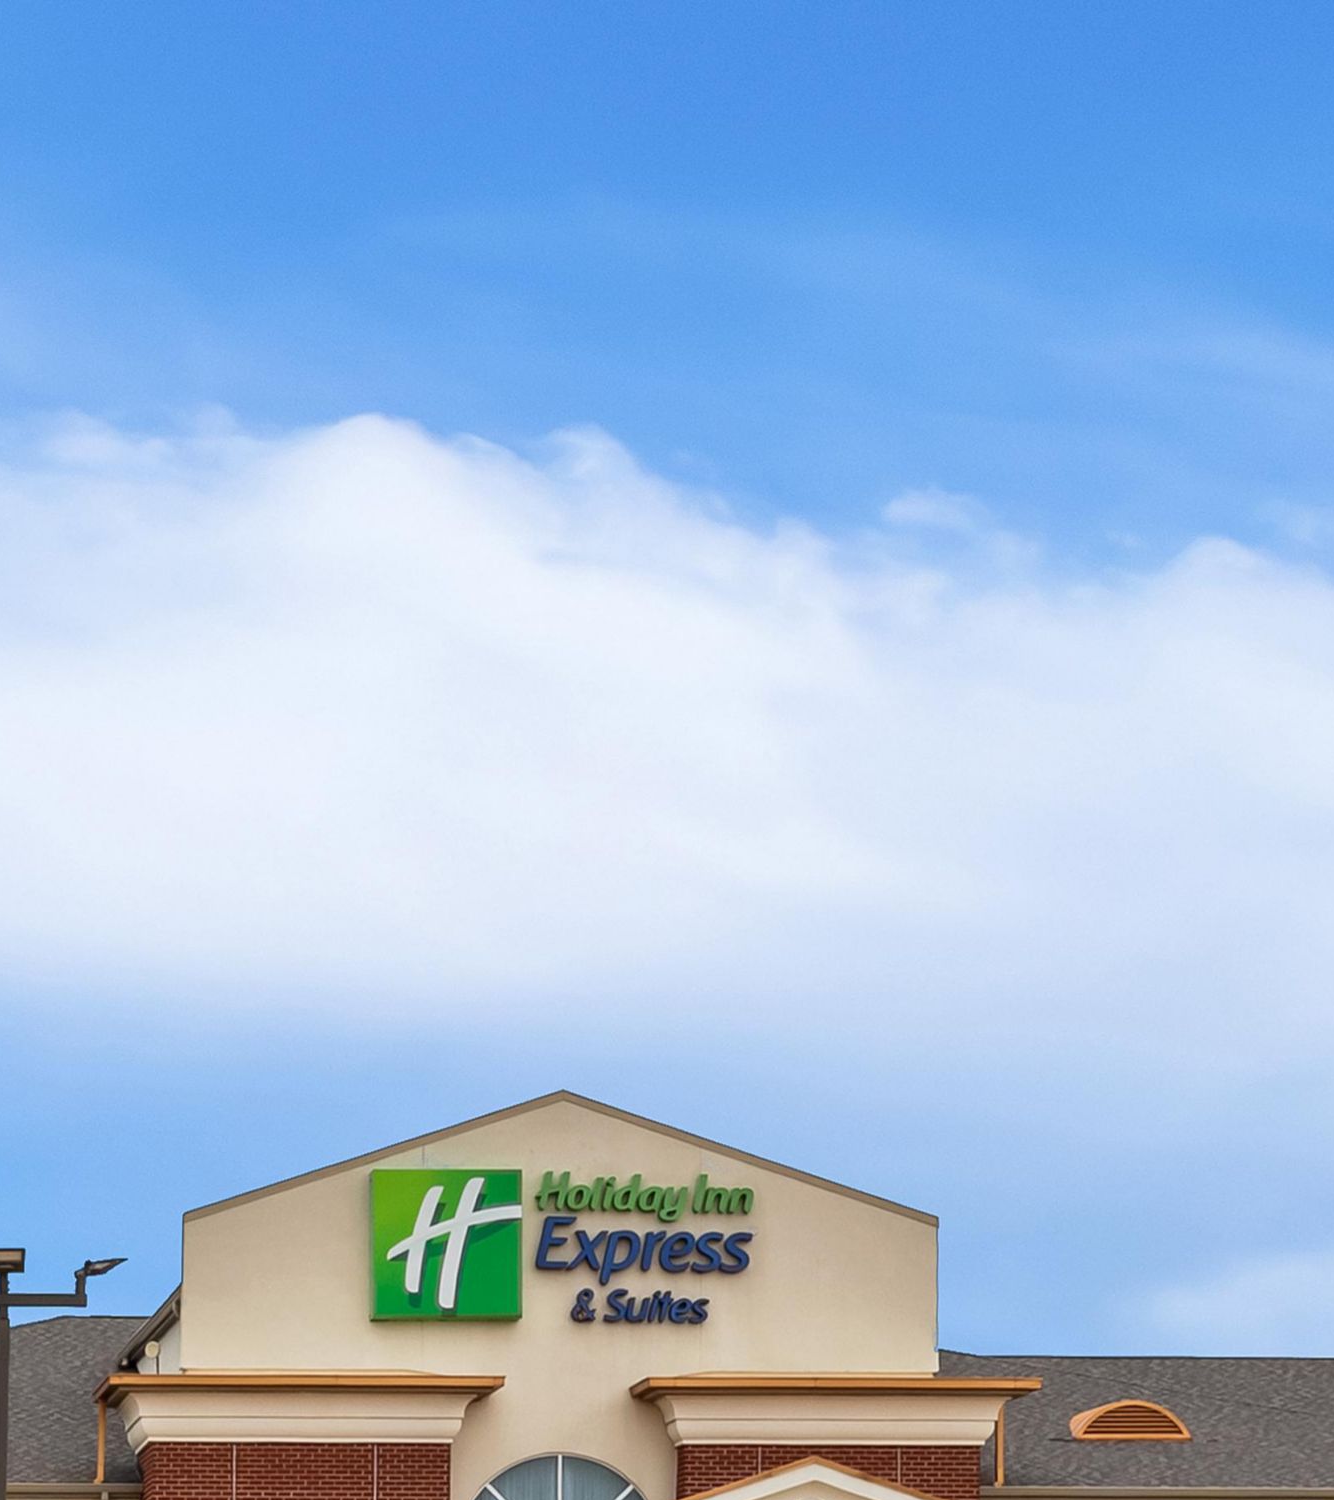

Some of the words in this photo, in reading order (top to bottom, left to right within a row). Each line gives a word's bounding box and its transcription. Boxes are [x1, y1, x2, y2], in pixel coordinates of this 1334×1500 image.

[535, 1171, 688, 1222] Holiday
[692, 1173, 754, 1214] Inn
[386, 1177, 522, 1309] H
[535, 1216, 753, 1286] Express
[570, 1288, 596, 1323] &
[603, 1288, 710, 1325] Suites
